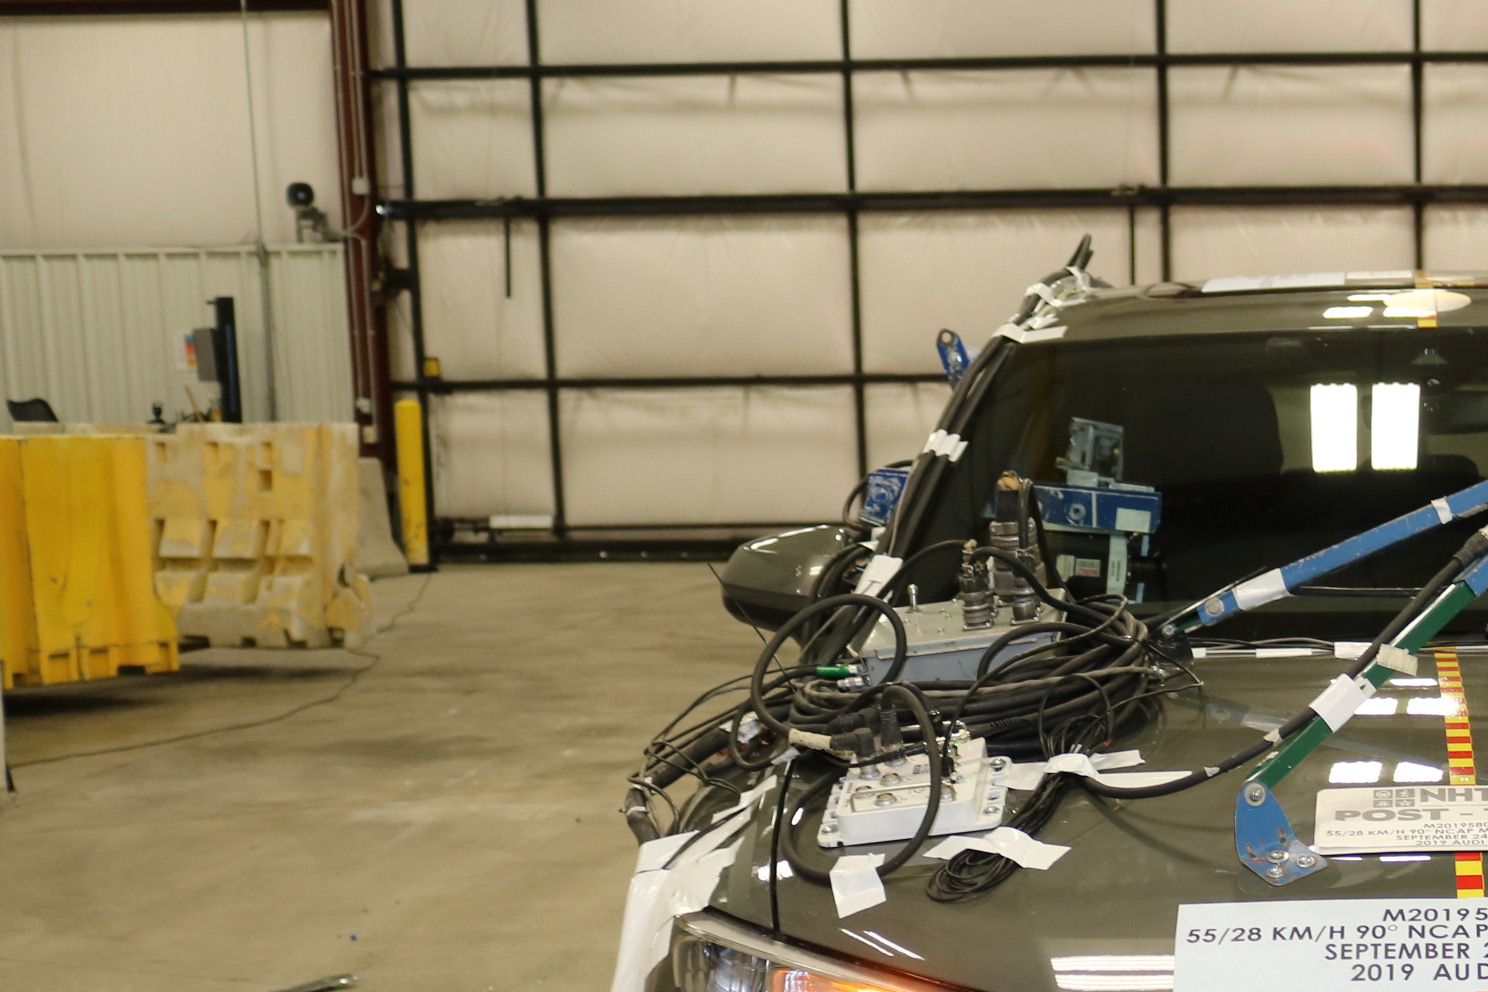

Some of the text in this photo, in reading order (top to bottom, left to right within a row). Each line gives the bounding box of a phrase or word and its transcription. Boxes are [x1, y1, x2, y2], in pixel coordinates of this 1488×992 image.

[1335, 808, 1450, 821] POST
[1186, 927, 1262, 945] 55/28
[1272, 926, 1345, 942] KM/H
[1408, 924, 1488, 939] NCAP
[1325, 943, 1470, 960] SEPTEMBER
[1351, 964, 1414, 982] 2019
